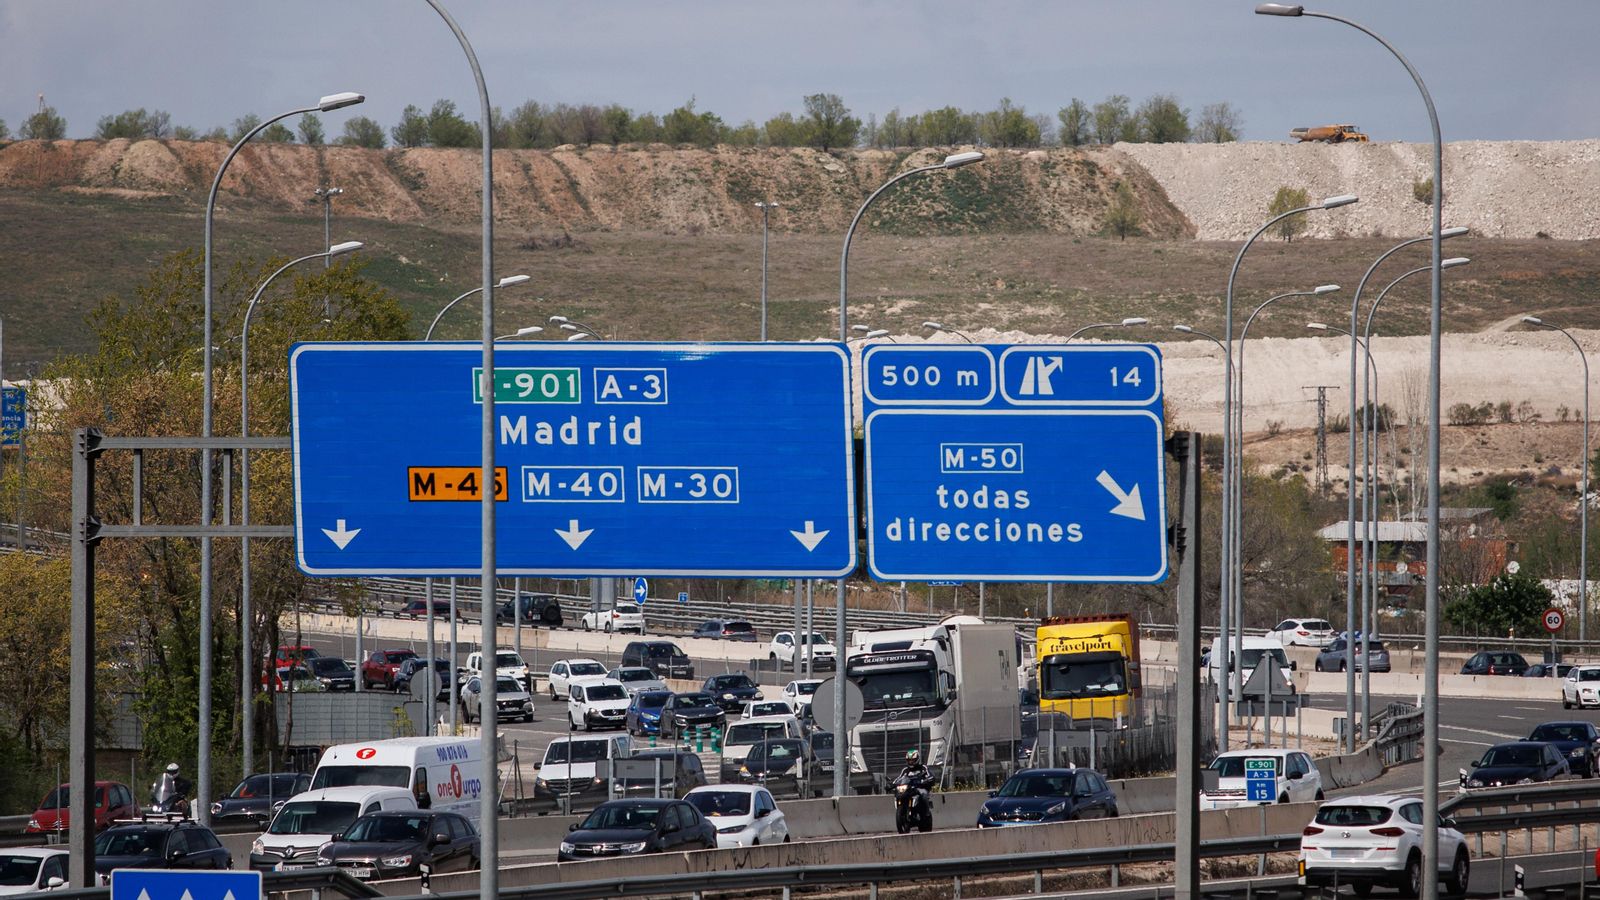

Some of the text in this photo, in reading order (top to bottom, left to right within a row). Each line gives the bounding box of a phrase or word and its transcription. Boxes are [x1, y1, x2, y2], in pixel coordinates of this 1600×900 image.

[601, 374, 662, 399] A-3
[882, 365, 979, 386] 500 m
[1110, 366, 1142, 387] 14
[500, 415, 642, 445] Madrid
[945, 448, 1018, 469] M-50
[528, 472, 618, 496] M-40
[643, 473, 732, 498] M-30
[936, 484, 1031, 509] todas
[886, 517, 1084, 542] direcciones
[1547, 616, 1560, 624] 60
[1050, 641, 1112, 653] travelport
[1255, 790, 1268, 799] 15
